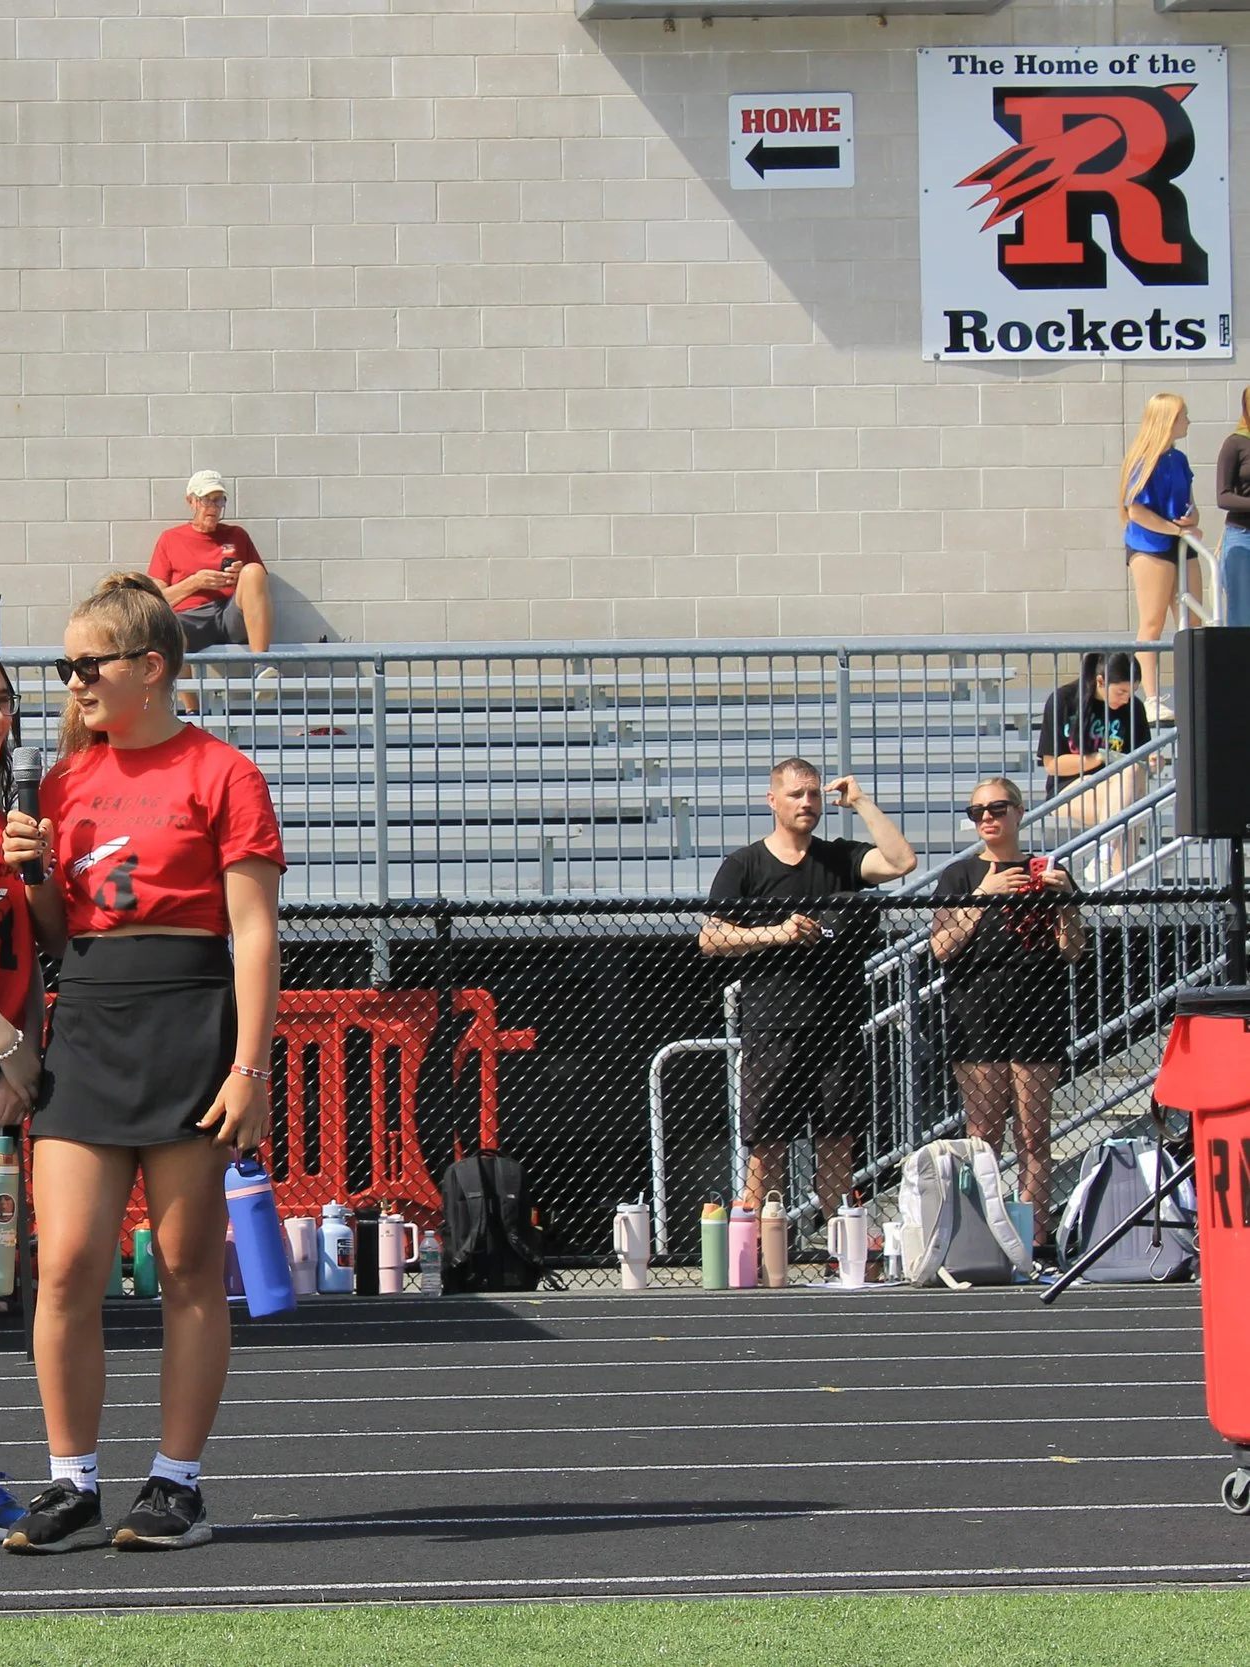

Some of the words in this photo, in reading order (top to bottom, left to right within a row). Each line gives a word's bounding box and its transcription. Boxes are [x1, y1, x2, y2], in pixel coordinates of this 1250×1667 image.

[948, 54, 1004, 75] The
[1014, 54, 1098, 75] Home
[1108, 53, 1140, 74] of
[1148, 53, 1196, 74] the
[740, 107, 841, 134] HOME
[943, 308, 1207, 353] Rockets
